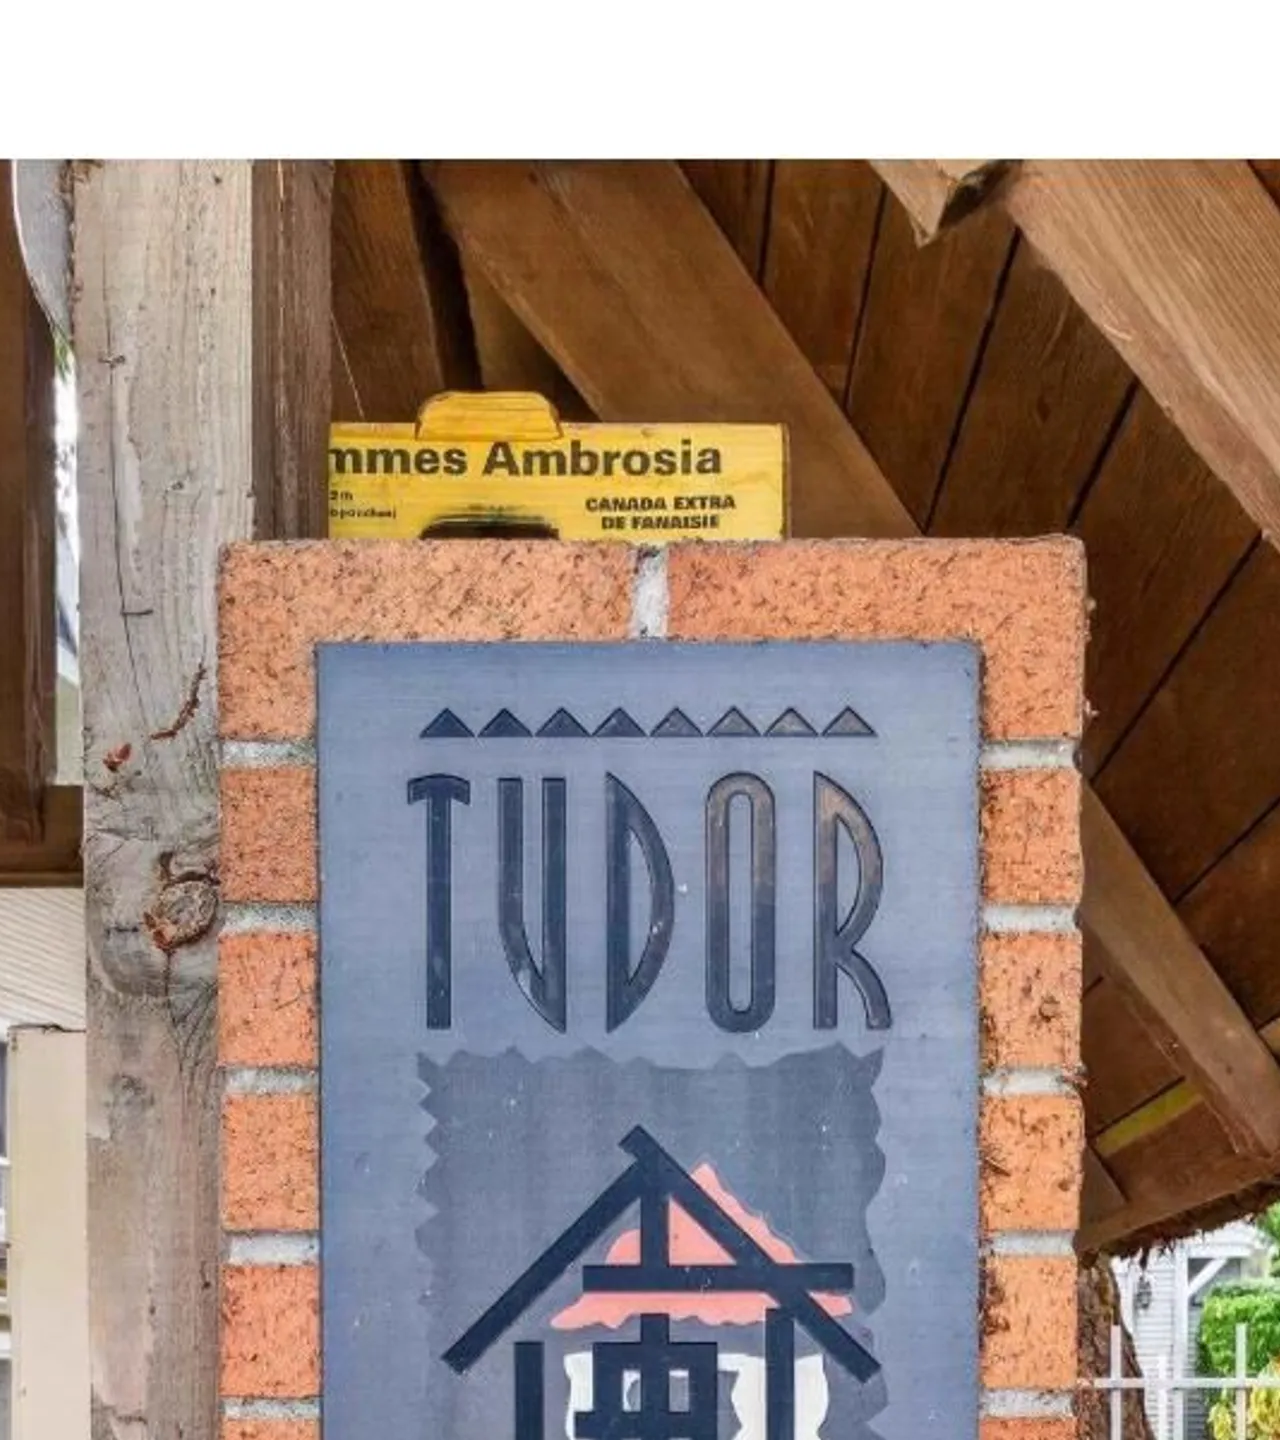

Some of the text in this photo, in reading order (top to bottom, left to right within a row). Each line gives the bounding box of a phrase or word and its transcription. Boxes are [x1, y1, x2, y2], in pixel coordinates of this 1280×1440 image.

[482, 439, 722, 476] Ambrosia
[585, 494, 736, 512] CANADA EXTRA
[601, 516, 625, 530] DE
[407, 769, 892, 1034] TUDOR
